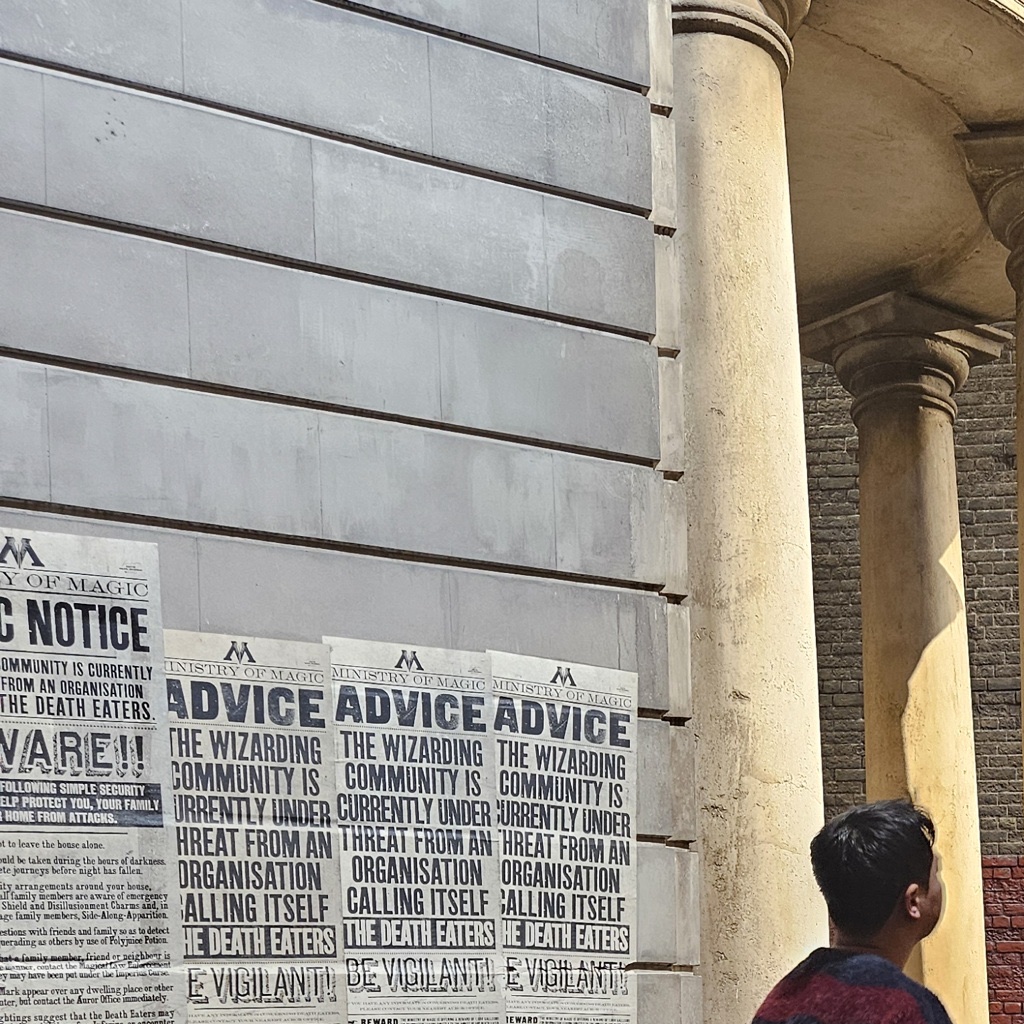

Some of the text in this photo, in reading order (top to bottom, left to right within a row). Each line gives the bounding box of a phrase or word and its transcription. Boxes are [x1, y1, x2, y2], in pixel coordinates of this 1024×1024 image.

[27, 574, 60, 589] OF
[67, 577, 149, 597] MAGIC
[26, 599, 150, 653] NOTICE
[0, 657, 153, 681] OMMUNITY IS CURRENTLY
[165, 661, 324, 684] INISTRY OF MAGIC
[332, 667, 485, 690] MINISTRY OF MAGIC
[1, 676, 144, 699] FROM AN ORGANISATION
[492, 679, 632, 708] MINISTRY OF MAGIC
[0, 694, 156, 721] THE DEATH EATERS.
[166, 678, 325, 728] ADVICE
[335, 685, 486, 732] ADVICE
[494, 696, 631, 748] ADVICE
[169, 728, 322, 765] THE WIZARDING
[340, 730, 483, 766] THE WIZARDING
[497, 739, 626, 780] THE WIZARDING
[0, 781, 145, 796] FOLLOWING SIMPLE SECURITY
[171, 761, 320, 796] COMMUNITY IS
[345, 762, 481, 797] COMMUNITY IS
[500, 770, 623, 808] COMMUNITY IS
[0, 796, 159, 811] ELP PROTECT YOU, YOUR FAMILY
[5, 810, 35, 823] HOME
[37, 811, 66, 823] FROM
[69, 812, 117, 824] ATTACKS.
[173, 794, 331, 828] URRENTLY UNDER
[337, 793, 492, 827] CURRENTLY UNDER
[583, 808, 631, 838] UNDER
[8, 840, 16, 848] to
[18, 839, 40, 848] leave
[42, 840, 55, 849] the
[57, 840, 80, 849] house
[176, 826, 332, 859] HREAT FROM AN
[338, 824, 492, 856] THREAT FROM AN
[498, 829, 630, 866] HREAT FROM AN
[17, 855, 26, 864] be
[28, 855, 51, 864] taken
[54, 855, 81, 867] during
[83, 856, 95, 865] the
[98, 855, 119, 865] hours
[121, 856, 128, 865] of
[178, 860, 322, 890] ORGANISATION
[352, 855, 482, 886] ORGANISATION
[15, 883, 73, 893] arrangements
[76, 882, 104, 890] around
[106, 884, 124, 893] your
[501, 859, 620, 894] ORGANISATION
[1, 901, 27, 910] Shield
[30, 901, 45, 910] and
[47, 901, 109, 910] Disillusionment
[111, 901, 140, 910] Charms
[161, 901, 168, 909] in
[180, 893, 329, 922] ALLING ITSELF
[347, 886, 489, 916] CALLING ITSELF
[572, 893, 625, 922] ITSELF
[15, 911, 41, 922] family
[184, 927, 334, 955] HE DEATH EATERS
[343, 919, 494, 947] THE DEATH EATERS
[502, 920, 628, 951] HE DEATH EATERS
[188, 966, 336, 1003] E VIGILANT!
[346, 957, 495, 992] BE VIGILANT!
[506, 957, 628, 994] E VIGILANT!
[22, 989, 49, 998] appear
[70, 988, 84, 997] any
[87, 985, 121, 996] dwelling
[123, 984, 143, 996] place
[154, 983, 174, 991] other
